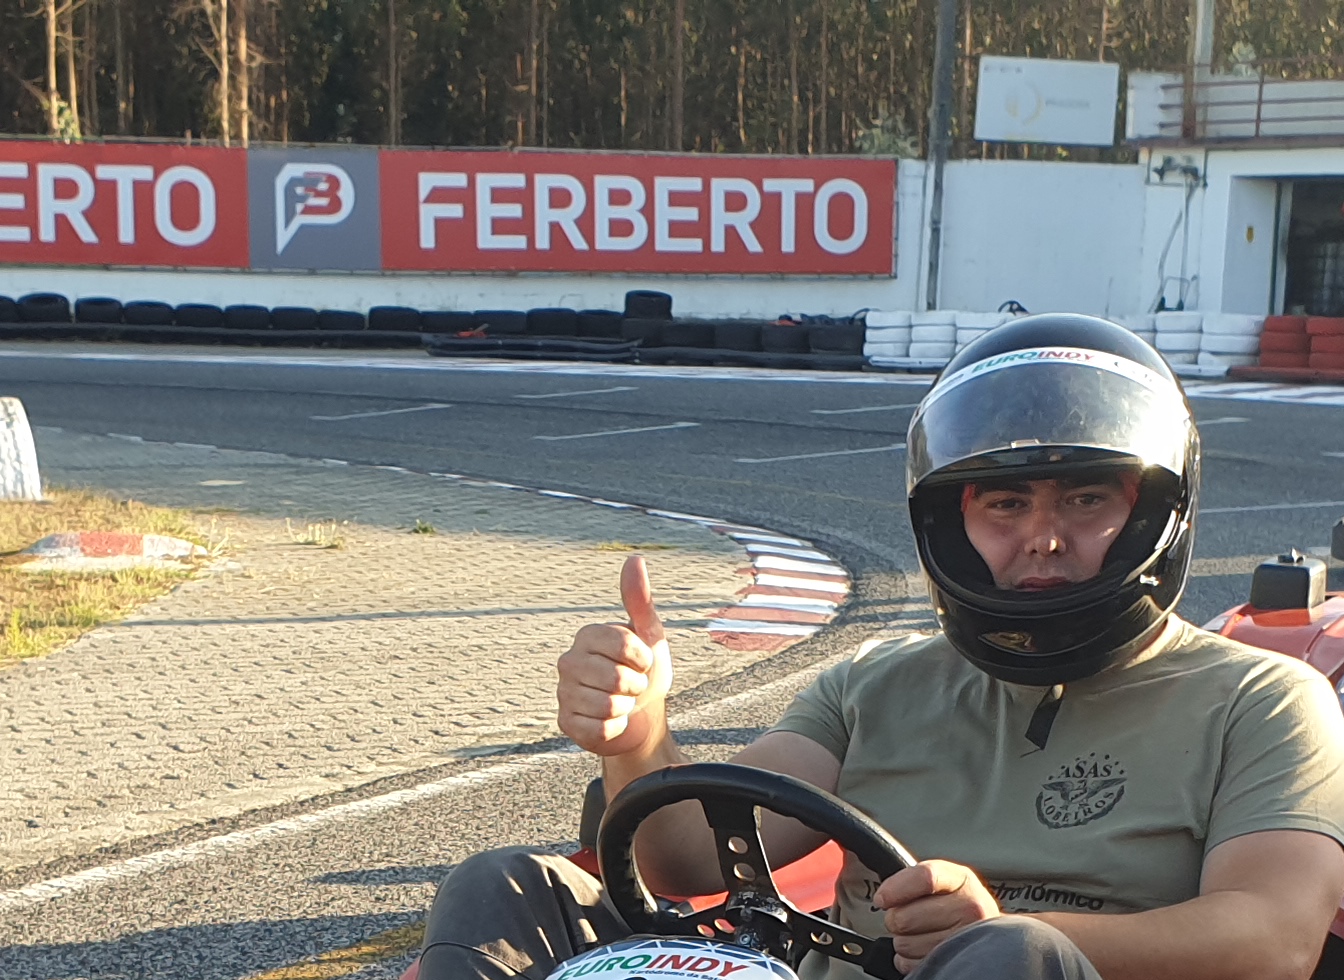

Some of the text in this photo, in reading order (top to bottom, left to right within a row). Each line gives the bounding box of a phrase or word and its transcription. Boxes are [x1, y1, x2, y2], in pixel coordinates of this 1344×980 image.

[418, 172, 869, 254] FERBERTO
[972, 350, 1095, 373] EUROINDY
[1058, 760, 1112, 778] ASAS
[991, 881, 1104, 911] tronómico
[687, 971, 699, 979] da
